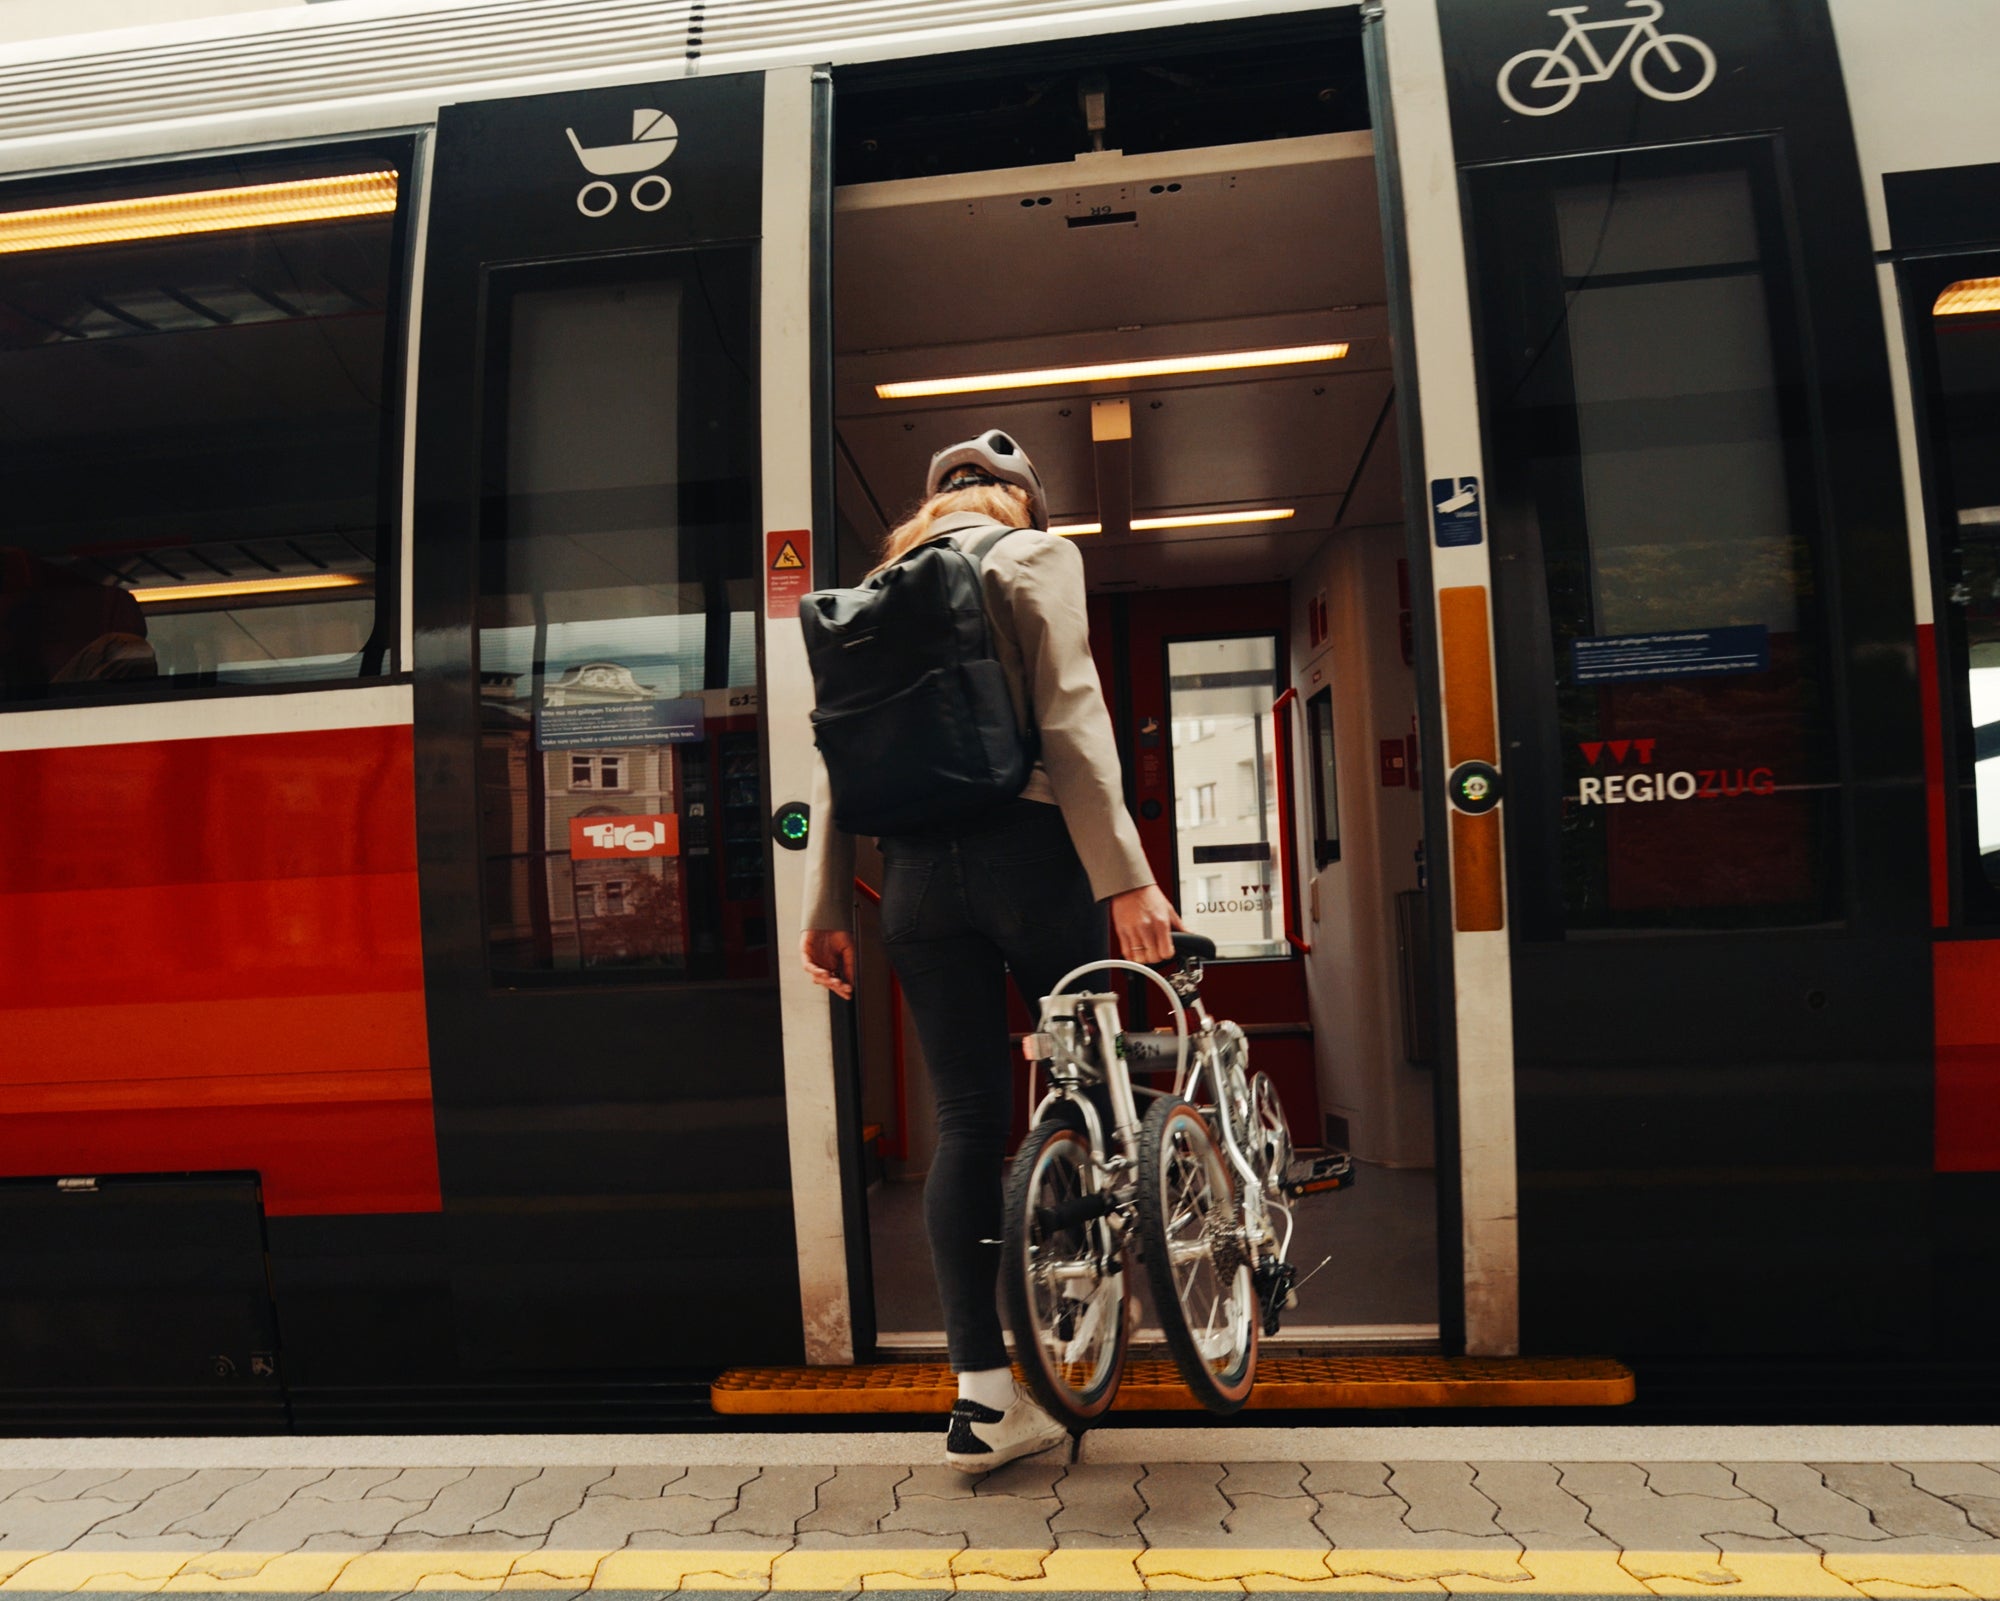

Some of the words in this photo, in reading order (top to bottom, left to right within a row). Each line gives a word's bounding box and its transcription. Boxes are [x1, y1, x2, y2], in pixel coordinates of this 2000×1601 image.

[1578, 738, 1656, 766] VVT
[1578, 767, 1775, 806] REGIOZUG
[583, 820, 666, 852] Tirol
